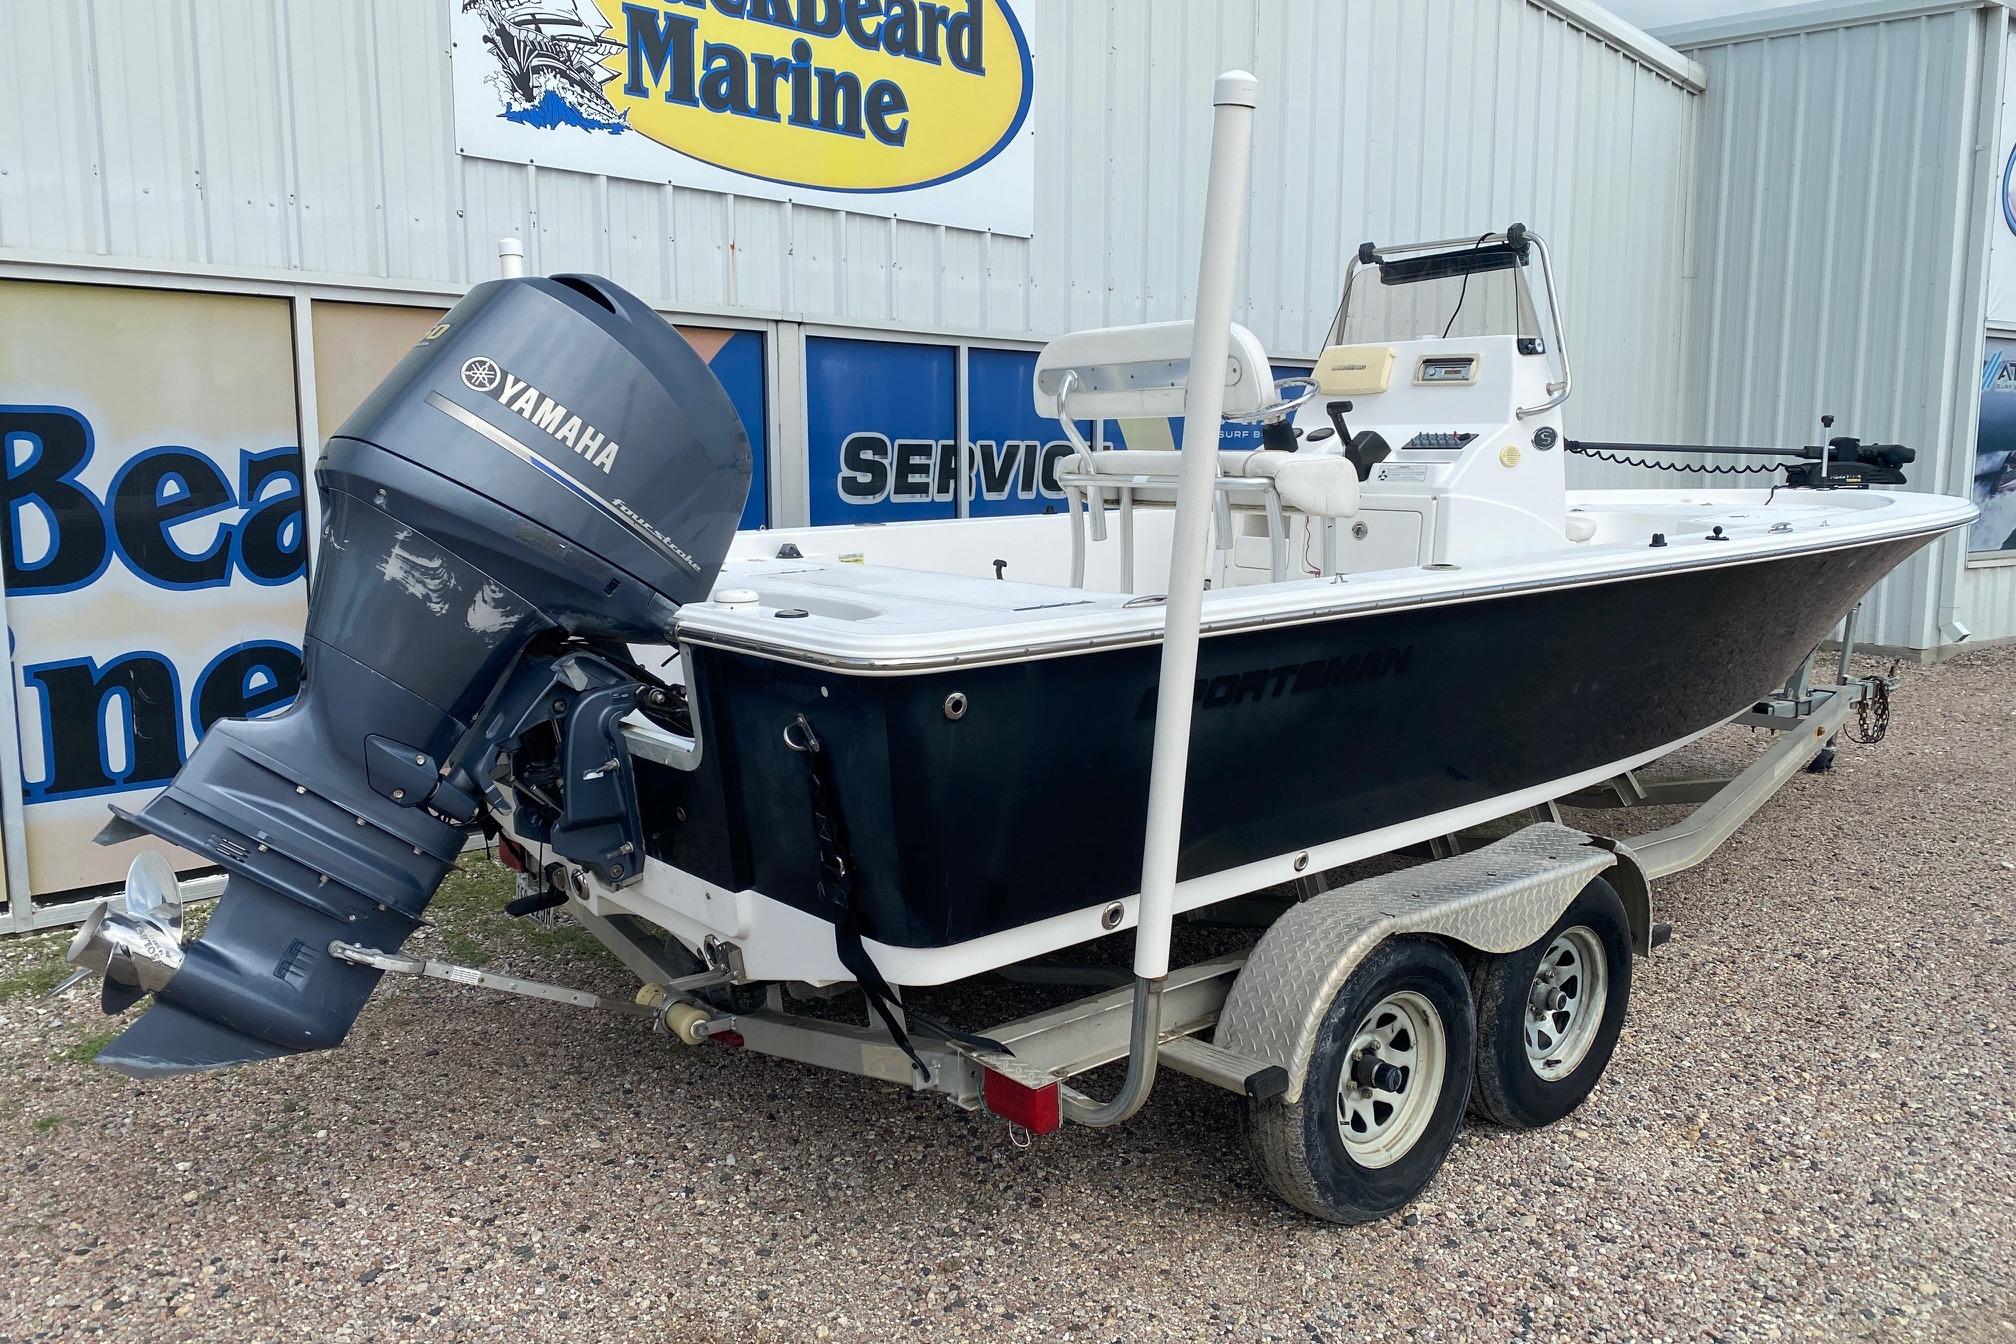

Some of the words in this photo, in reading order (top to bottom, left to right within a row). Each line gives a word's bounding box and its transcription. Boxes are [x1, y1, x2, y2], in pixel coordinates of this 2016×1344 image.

[622, 2, 909, 147] Marine
[498, 373, 620, 475] YAMAHA
[838, 432, 1113, 504] SERVIC
[1134, 645, 1414, 721] ORTSMAN
